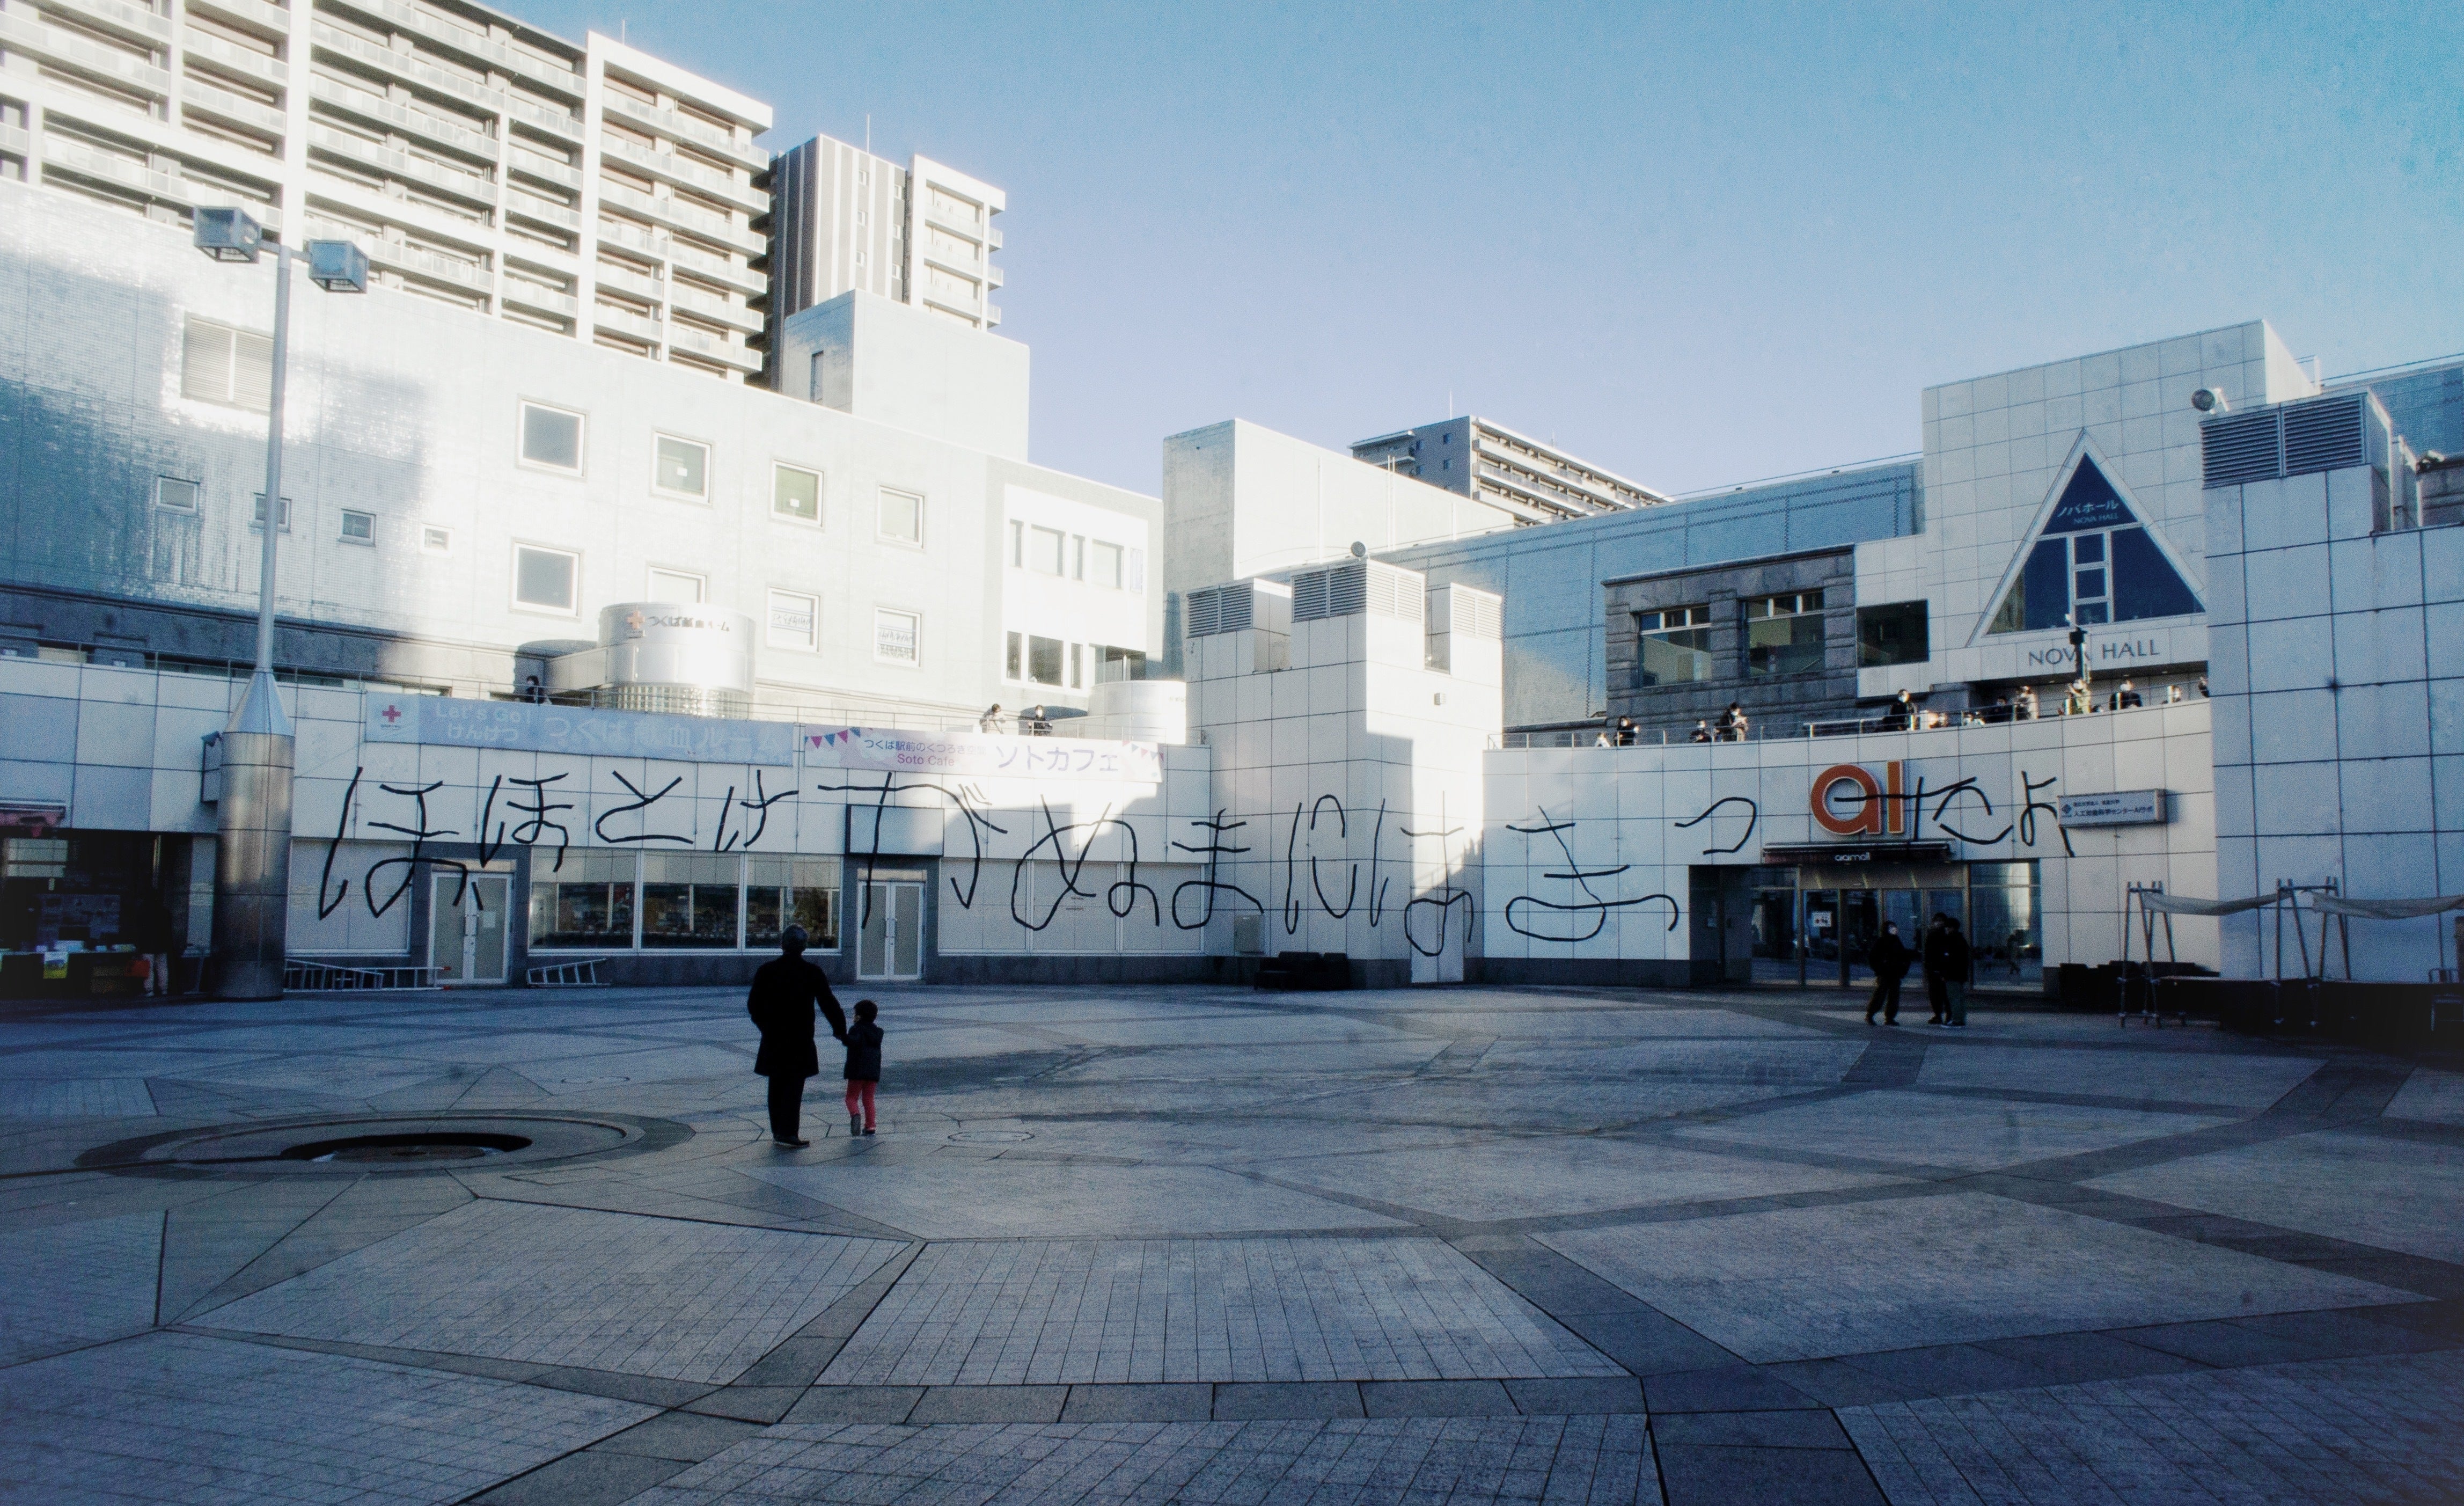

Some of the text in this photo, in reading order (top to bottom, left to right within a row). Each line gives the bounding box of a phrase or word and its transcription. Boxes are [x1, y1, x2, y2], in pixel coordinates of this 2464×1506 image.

[2057, 500, 2120, 517] ノバホール
[2073, 512, 2120, 524] NOVA HALL
[2028, 639, 2160, 666] NOV HALL
[435, 701, 487, 721] Let's
[447, 723, 519, 743] けんけつ
[544, 716, 781, 752] つくば献血ルーム
[897, 753, 956, 766] Soto Cafe
[995, 745, 1119, 772] ソトカフェ
